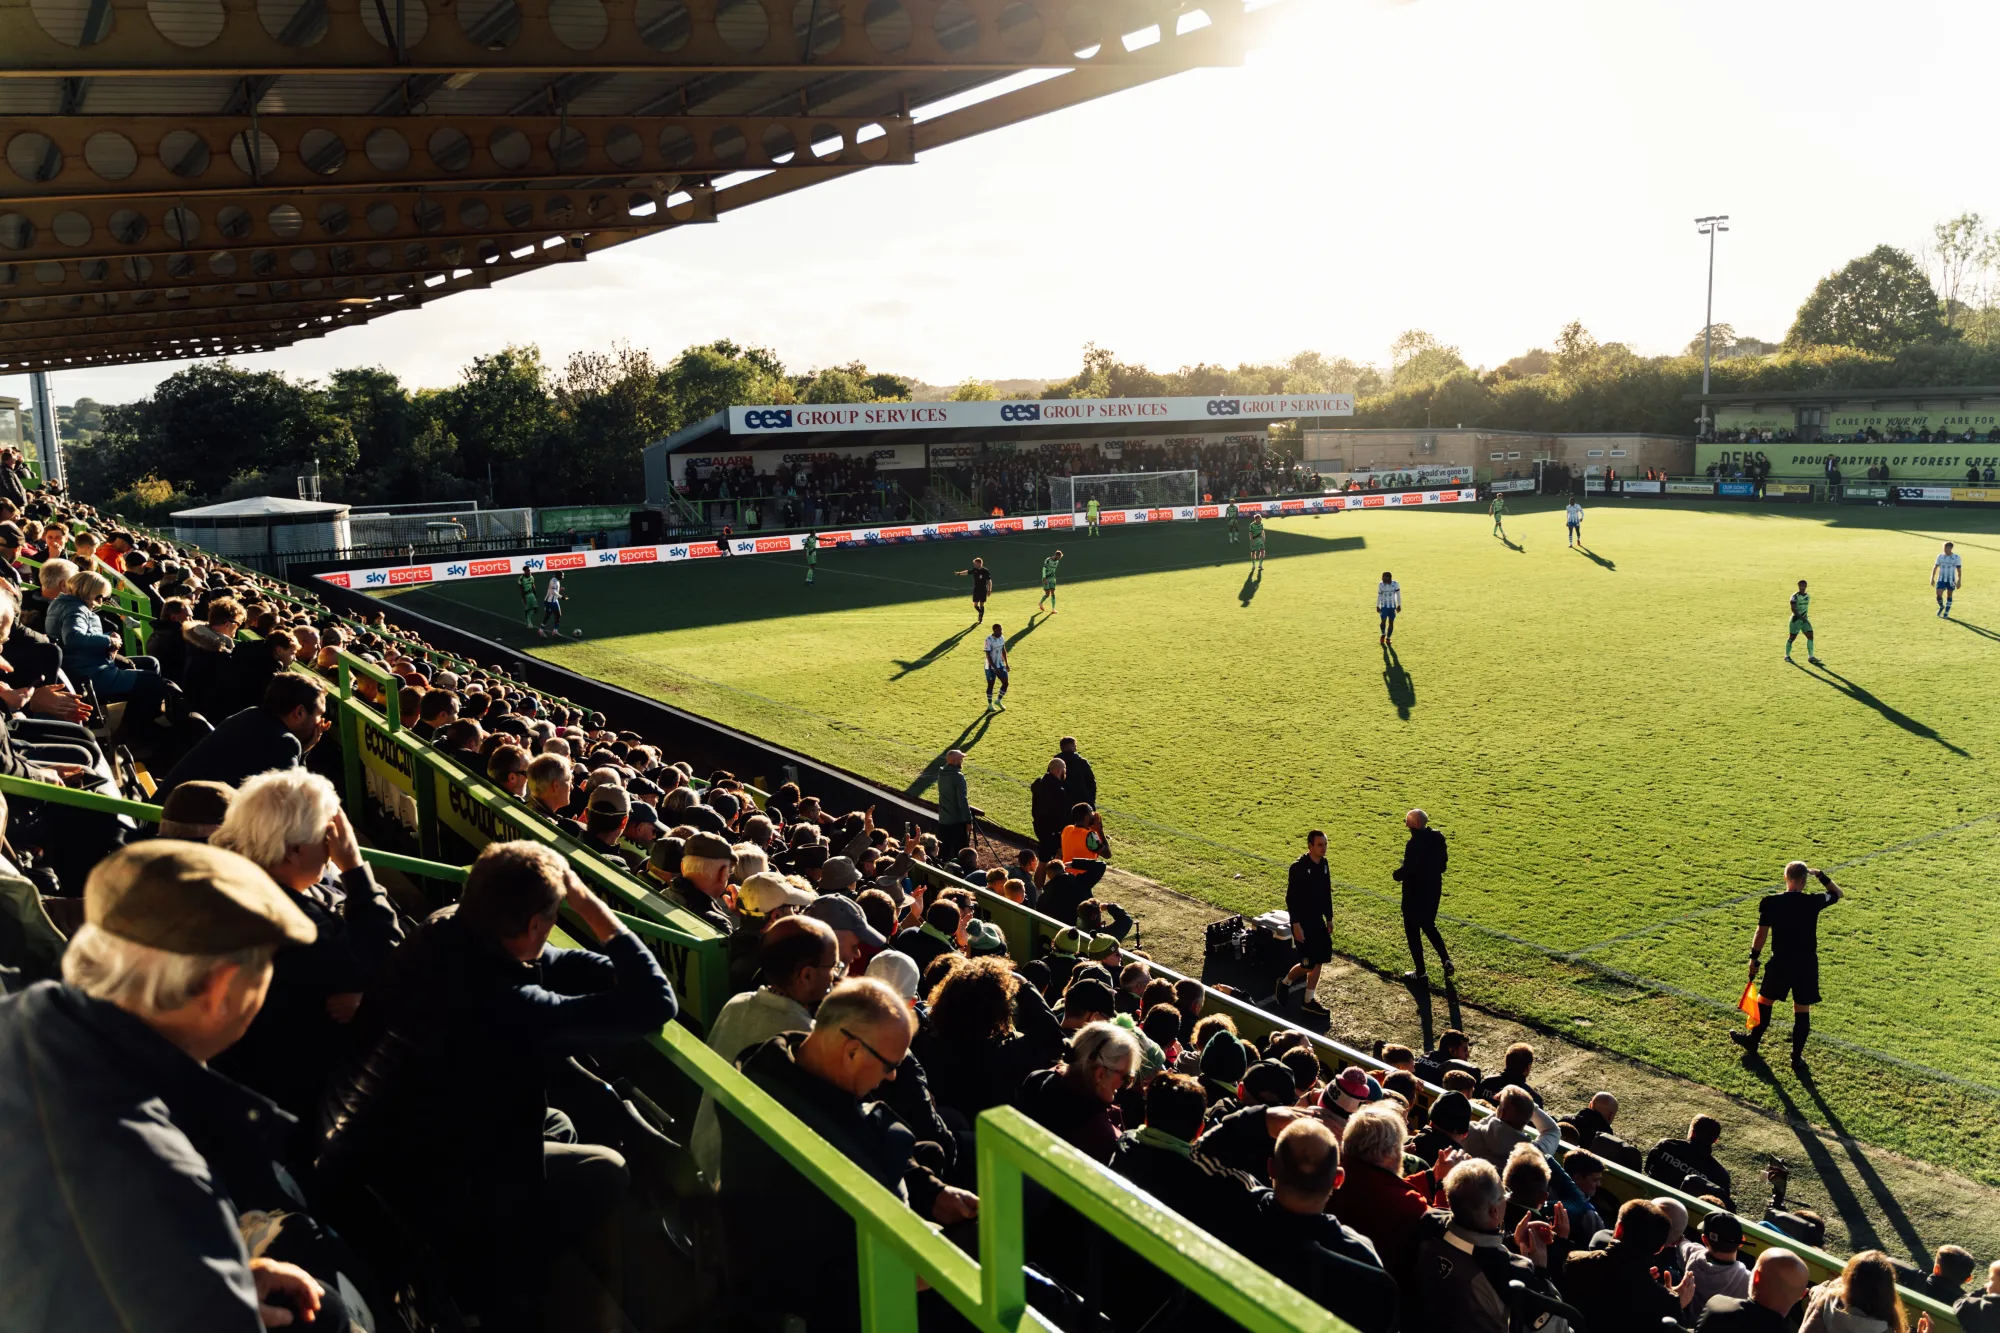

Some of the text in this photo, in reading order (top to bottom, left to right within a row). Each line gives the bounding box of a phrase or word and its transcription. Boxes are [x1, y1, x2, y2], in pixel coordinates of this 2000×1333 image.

[1001, 403, 1167, 421] eesi GROUP SERVICES
[1207, 400, 1350, 415] eesi GROUP SERVICES
[745, 408, 947, 429] eesi GROUP SERVICES
[1886, 417, 1910, 427] YOUR
[1944, 417, 1969, 425] CARE
[1792, 456, 2000, 466] PROUD PARTNER OF FOREST GREE
[1324, 499, 1344, 507] sports
[1364, 497, 1384, 505] sports
[1392, 495, 1422, 504] sky sports
[1101, 514, 1124, 523] sports
[1134, 512, 1172, 521] sky sports
[1182, 509, 1193, 518] sky
[1033, 517, 1073, 528] sky sports
[738, 541, 754, 552] sky
[757, 539, 789, 550] sports
[599, 549, 655, 563] sky sports
[670, 545, 722, 558] sky sport
[525, 556, 584, 570] sky sports
[447, 562, 509, 576] sky sports
[366, 568, 431, 584] sky sports
